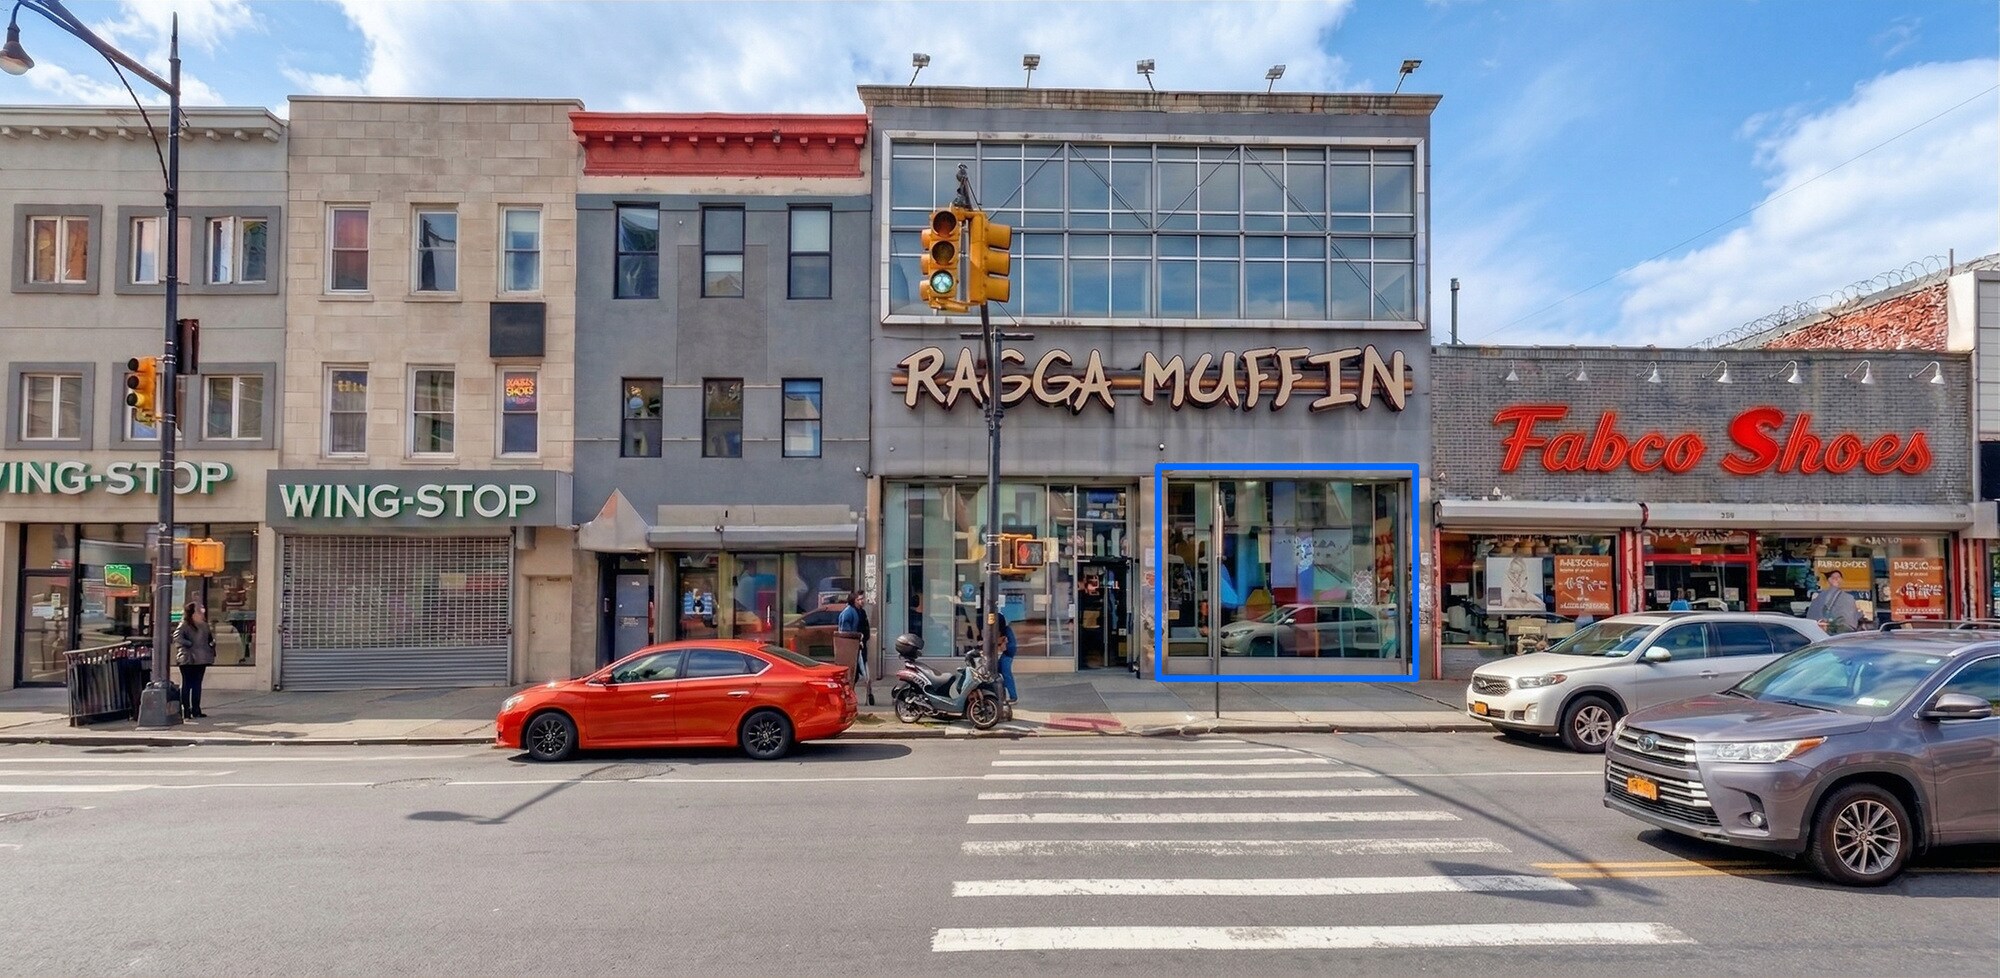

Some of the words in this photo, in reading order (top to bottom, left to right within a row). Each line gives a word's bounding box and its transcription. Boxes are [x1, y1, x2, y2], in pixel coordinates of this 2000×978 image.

[899, 345, 1115, 413] RAGGA
[1140, 344, 1407, 413] MUFFIN
[1493, 405, 1706, 474] Fabco
[1721, 406, 1934, 476] Shoes
[0, 461, 233, 495] ING-STOP
[279, 484, 538, 519] WING-STOP
